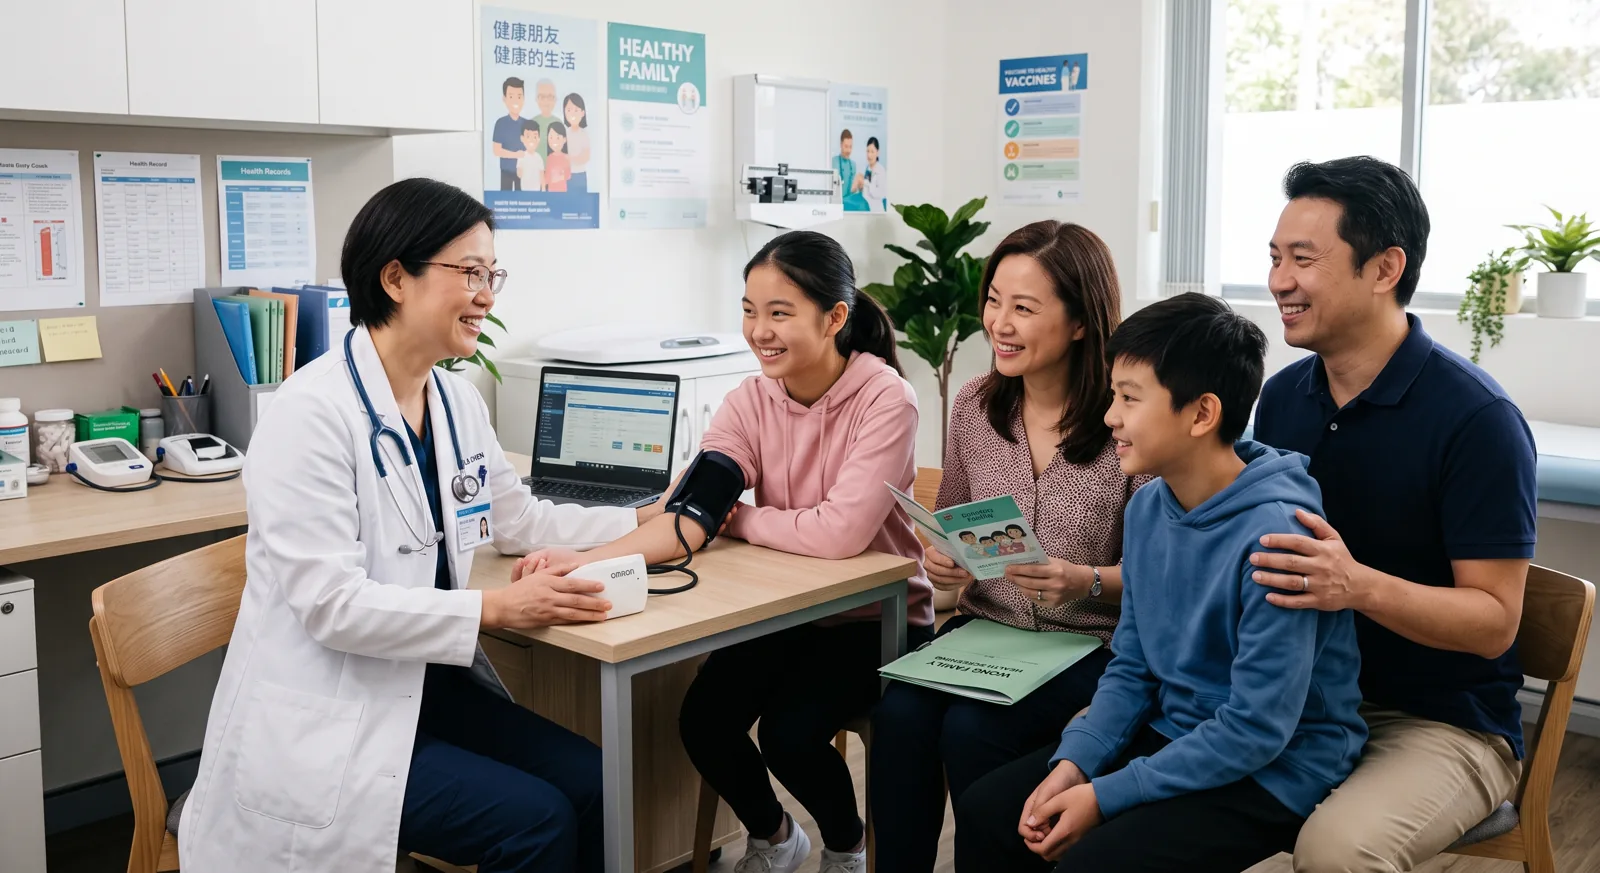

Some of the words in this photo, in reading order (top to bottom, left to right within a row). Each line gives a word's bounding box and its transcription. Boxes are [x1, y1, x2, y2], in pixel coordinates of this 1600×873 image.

[493, 20, 560, 45] 健康朋友
[619, 37, 695, 63] HEALTHY
[494, 45, 576, 71] 健康的生活
[619, 60, 681, 83] FAMILY
[1004, 74, 1057, 88] VACCINES
[240, 167, 264, 176] Health
[264, 168, 292, 176] Records
[610, 568, 635, 579] OMRON
[926, 660, 970, 672] FAMILY
[935, 655, 987, 667] SCREENING
[971, 668, 1011, 679] WONG
[988, 664, 1024, 673] HEALTH
